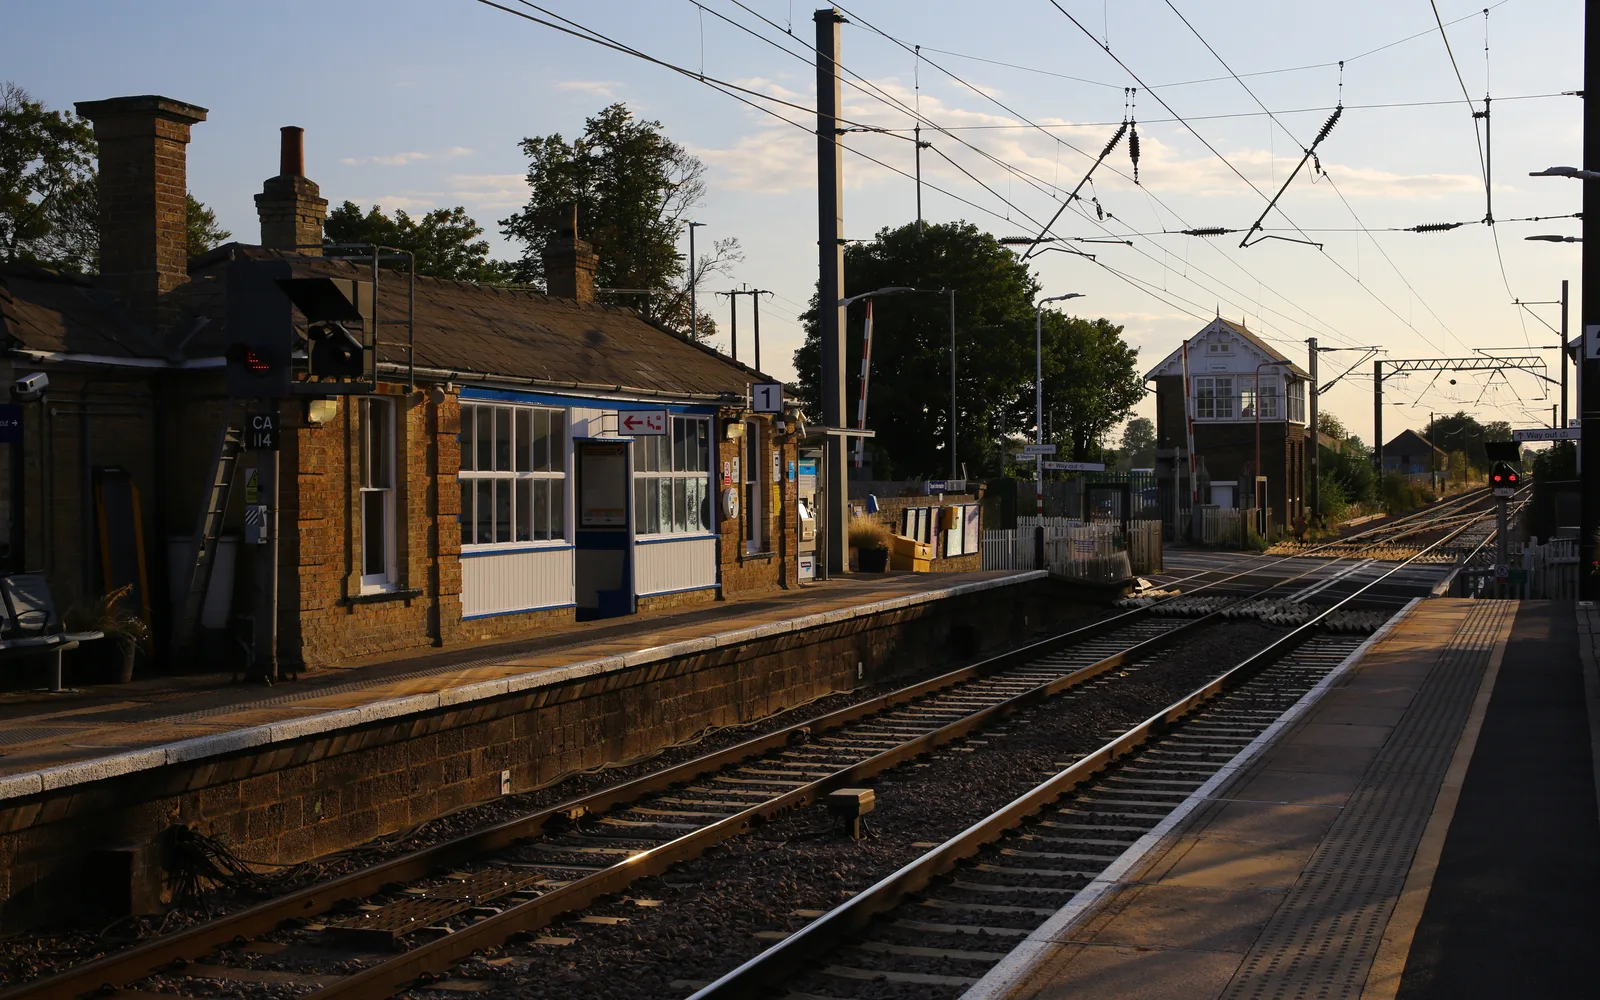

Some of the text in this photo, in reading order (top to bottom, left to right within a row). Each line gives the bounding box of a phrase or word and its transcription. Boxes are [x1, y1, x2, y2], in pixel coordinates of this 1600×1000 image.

[761, 387, 770, 409] 1
[252, 415, 273, 430] CA
[253, 432, 272, 447] 114
[1526, 432, 1543, 440] Way
